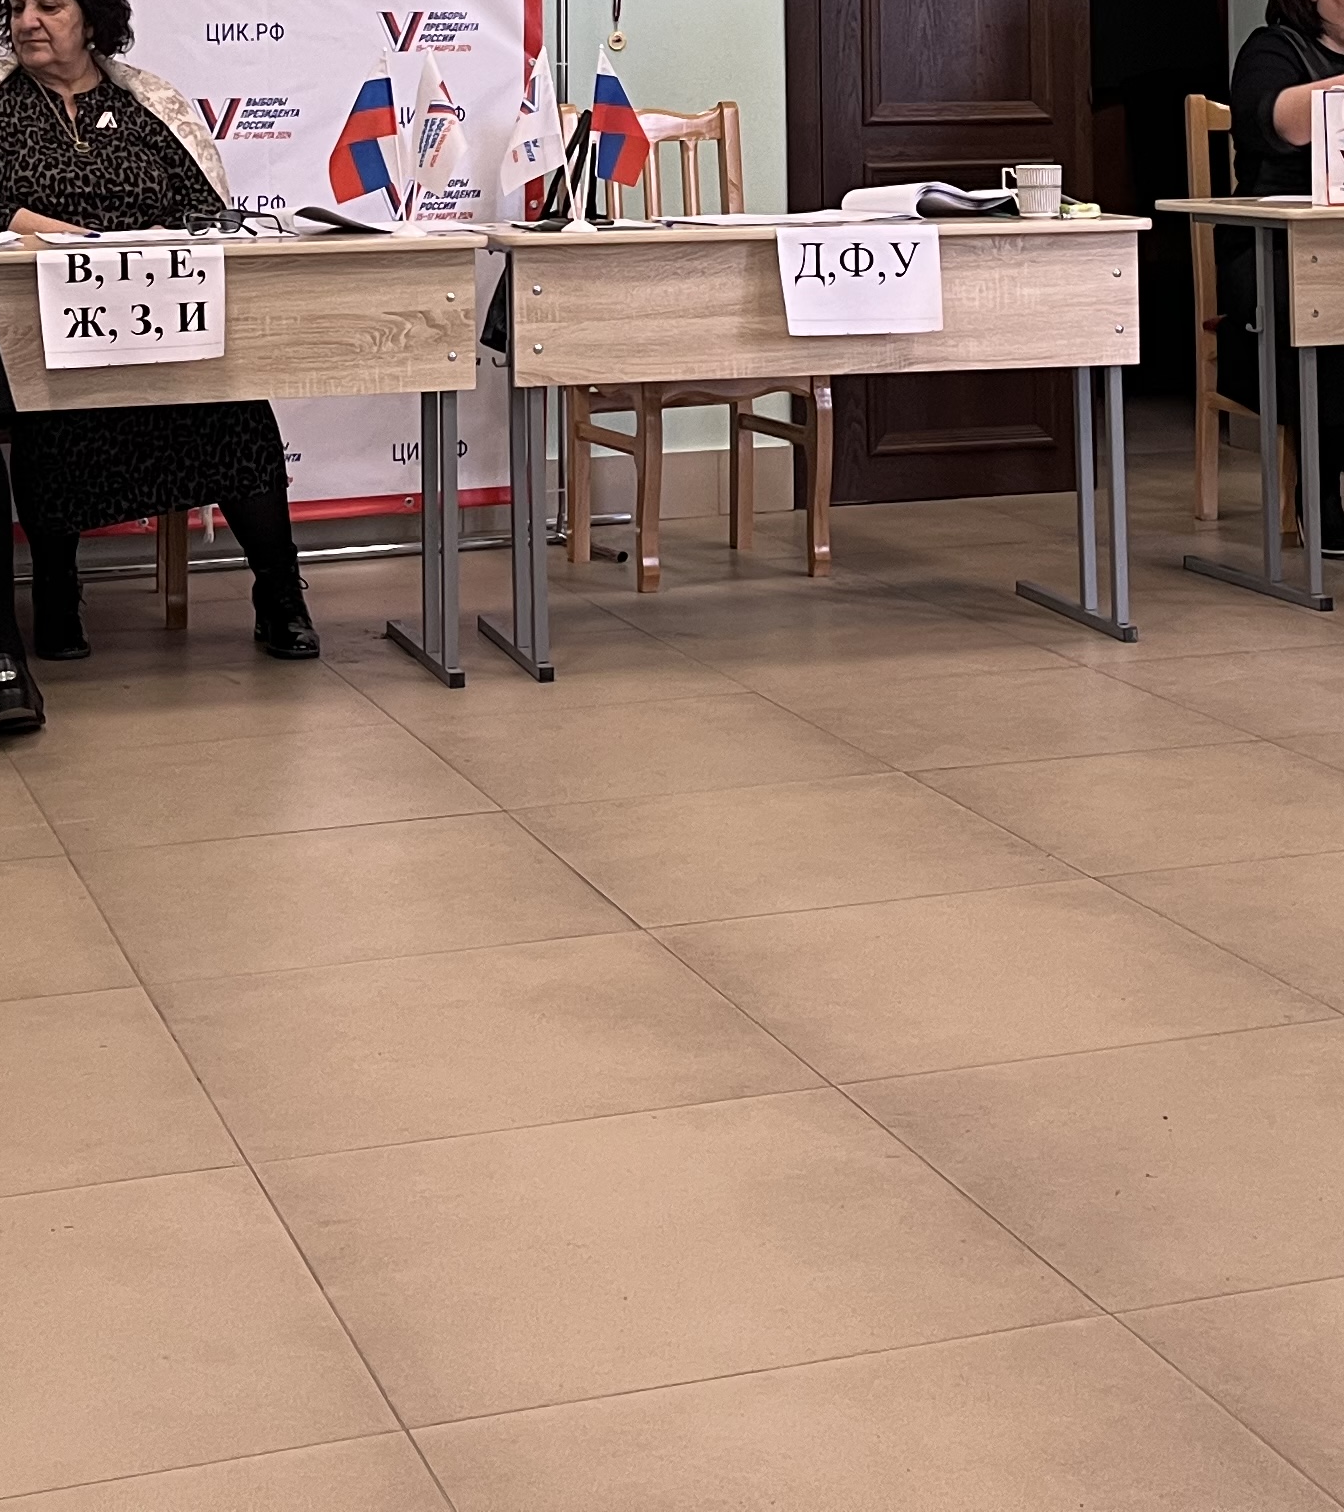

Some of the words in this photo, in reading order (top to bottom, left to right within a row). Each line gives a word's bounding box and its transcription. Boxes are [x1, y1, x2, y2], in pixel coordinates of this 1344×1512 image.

[427, 12, 467, 21] ВЫБОРЫ
[423, 22, 479, 33] ПРЕЗИДЕНТА
[206, 22, 285, 45] ЦИК.РФ
[418, 33, 455, 43] РОССИИ
[245, 97, 288, 107] ВЫБОРЫ
[241, 108, 300, 118] ПРЕЗИДЕНТА
[236, 120, 274, 130] РОССИИ
[423, 190, 481, 200] ПЗИДЕНТА
[419, 202, 457, 211] РОССИИ
[65, 253, 104, 289] В,
[167, 249, 206, 285] Е,
[63, 306, 118, 344] Ж,
[131, 303, 164, 342] З,
[176, 301, 209, 333] И
[392, 439, 468, 465] ЦИФ
